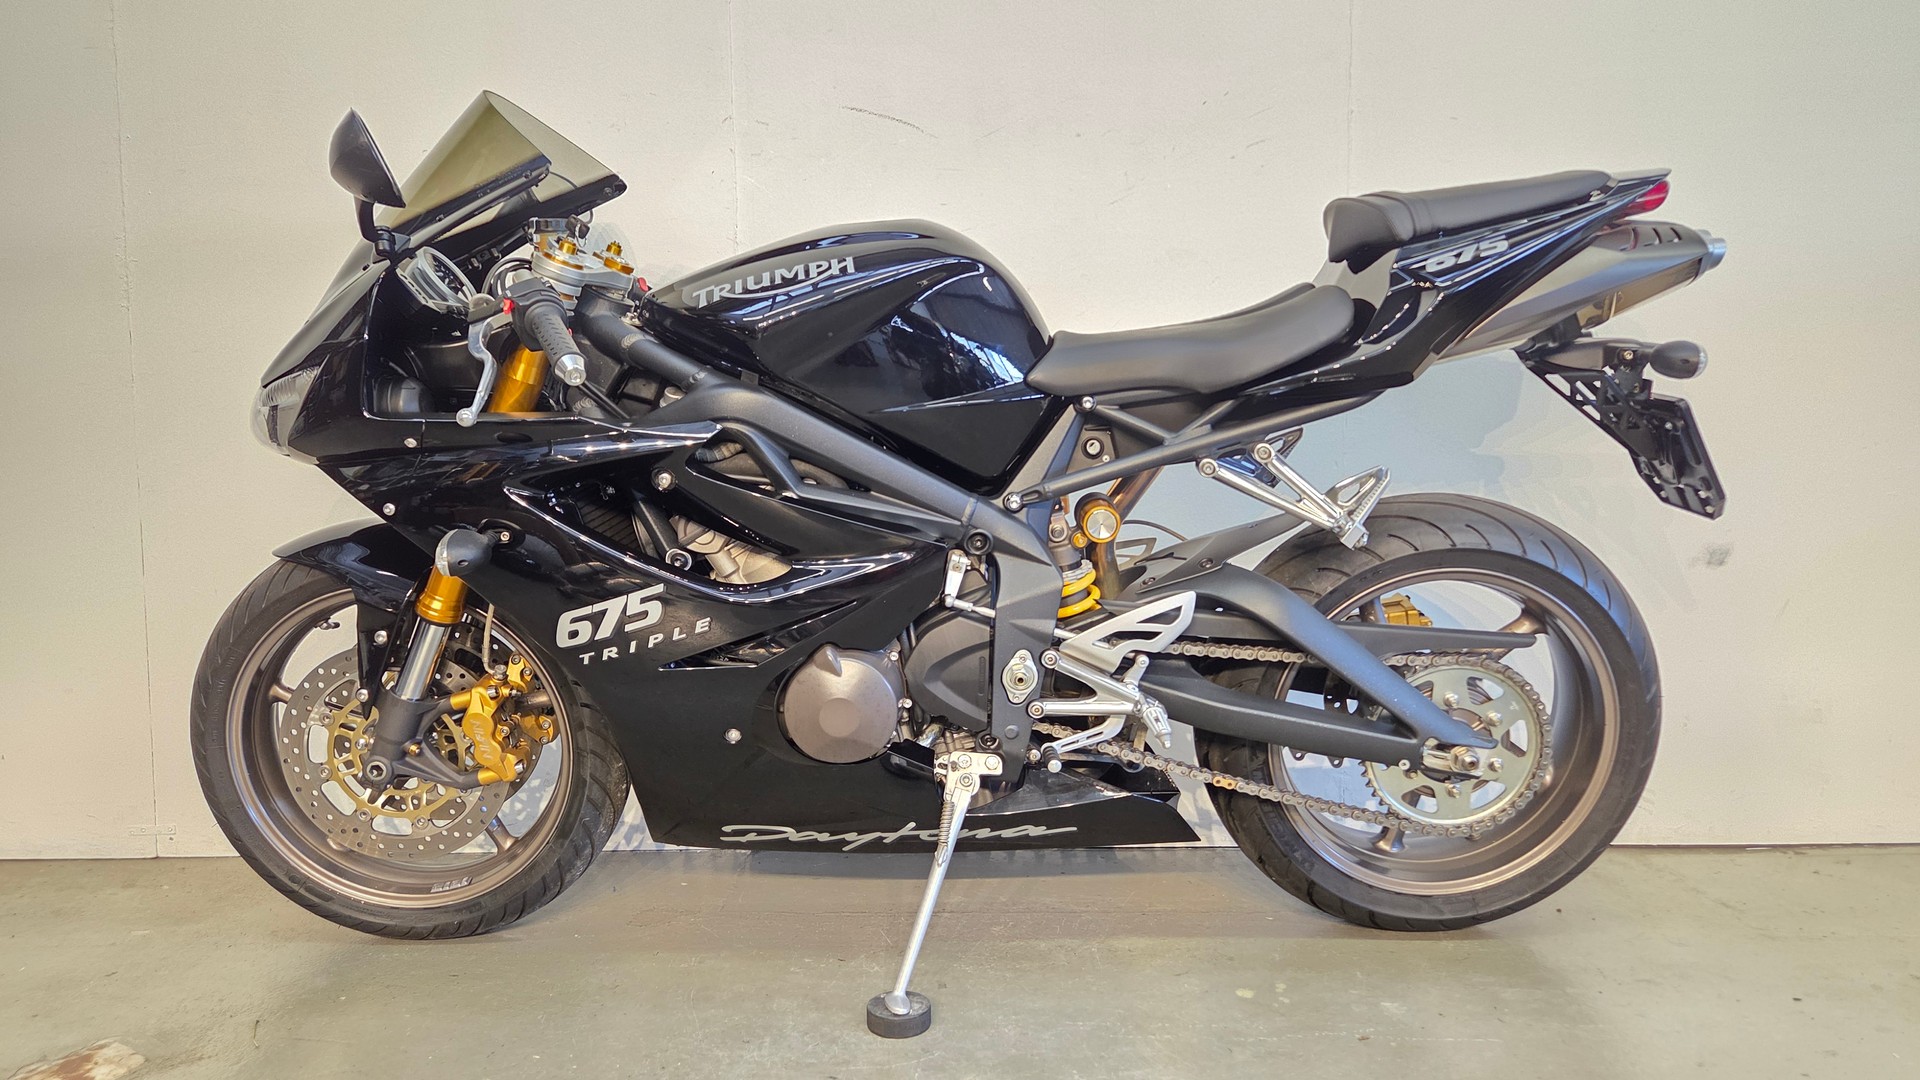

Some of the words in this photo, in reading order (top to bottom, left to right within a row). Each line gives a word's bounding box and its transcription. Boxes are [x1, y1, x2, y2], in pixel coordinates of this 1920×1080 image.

[1425, 235, 1509, 273] 675
[693, 256, 855, 308] TRIUMPH
[555, 583, 667, 648] 675
[579, 617, 711, 665] TRIPLE
